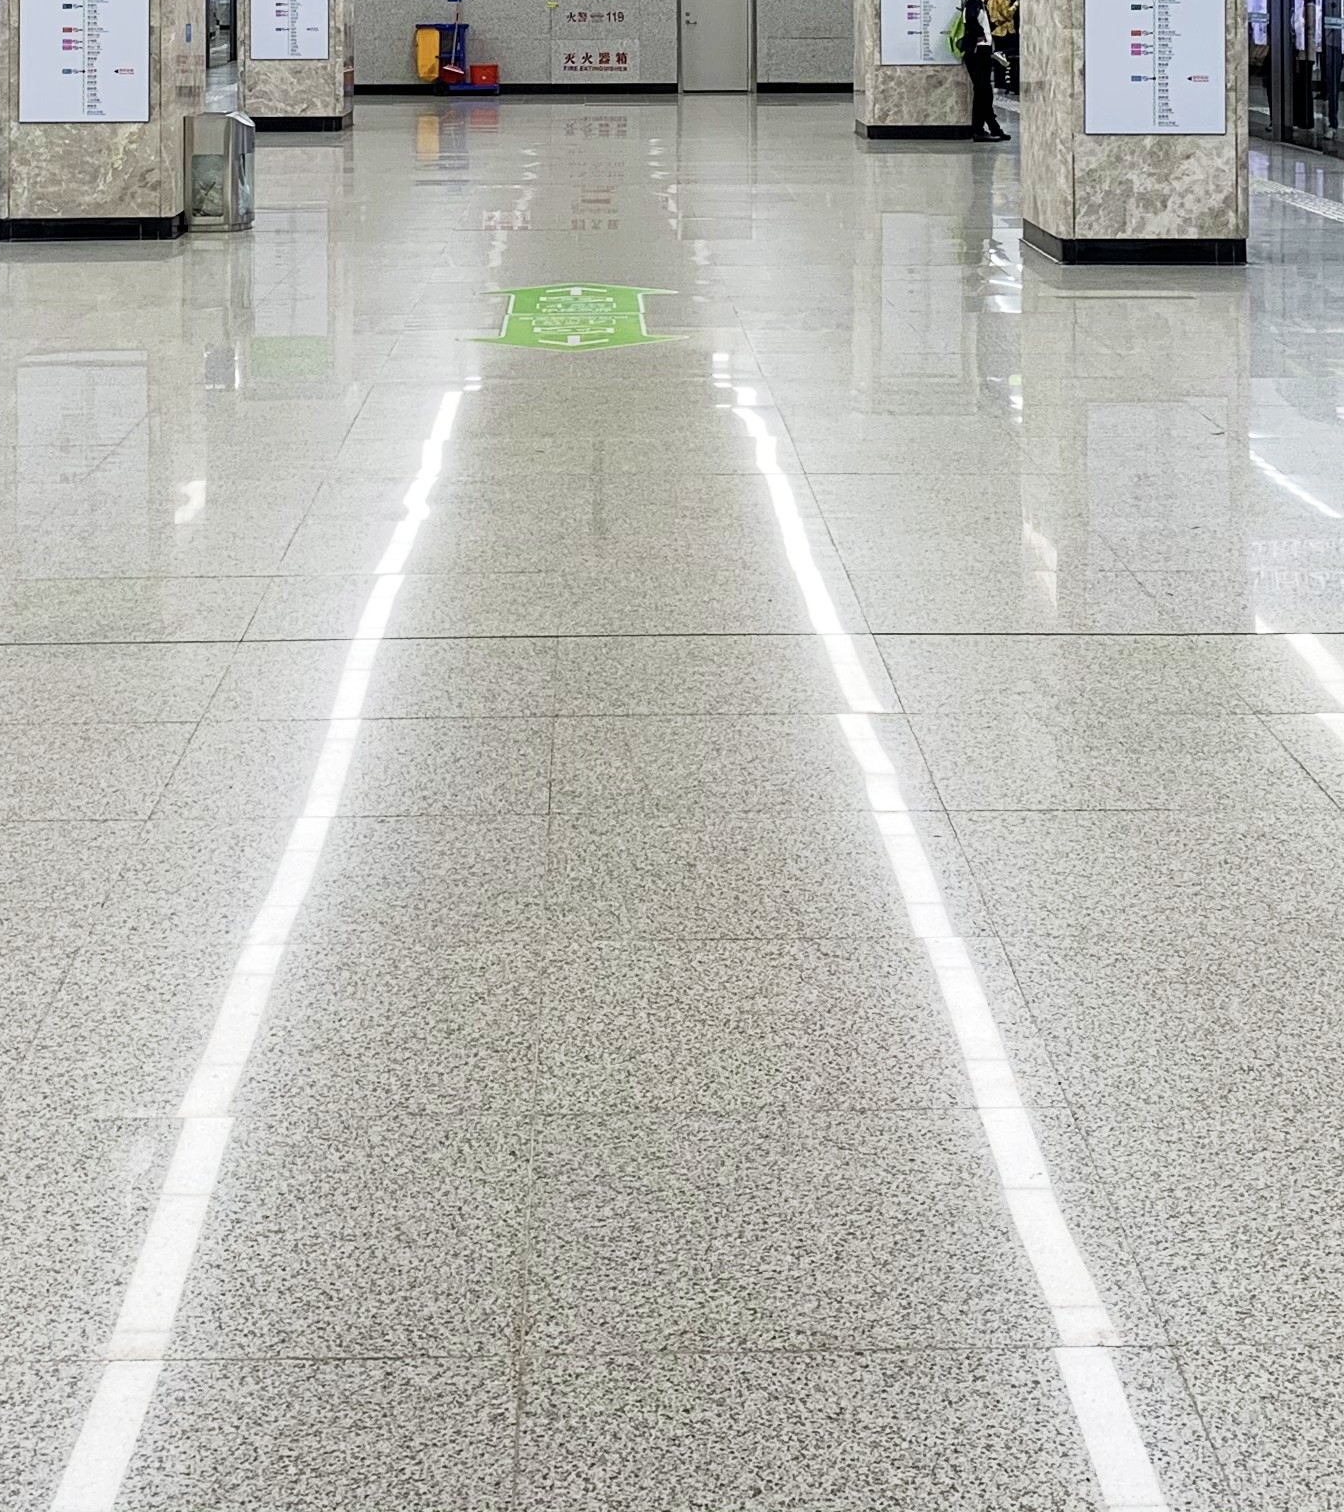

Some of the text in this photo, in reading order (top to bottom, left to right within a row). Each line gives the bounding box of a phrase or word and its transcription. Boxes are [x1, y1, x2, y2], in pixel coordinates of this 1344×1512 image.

[566, 11, 625, 23] 火警 119
[563, 52, 628, 65] 灭火器箱
